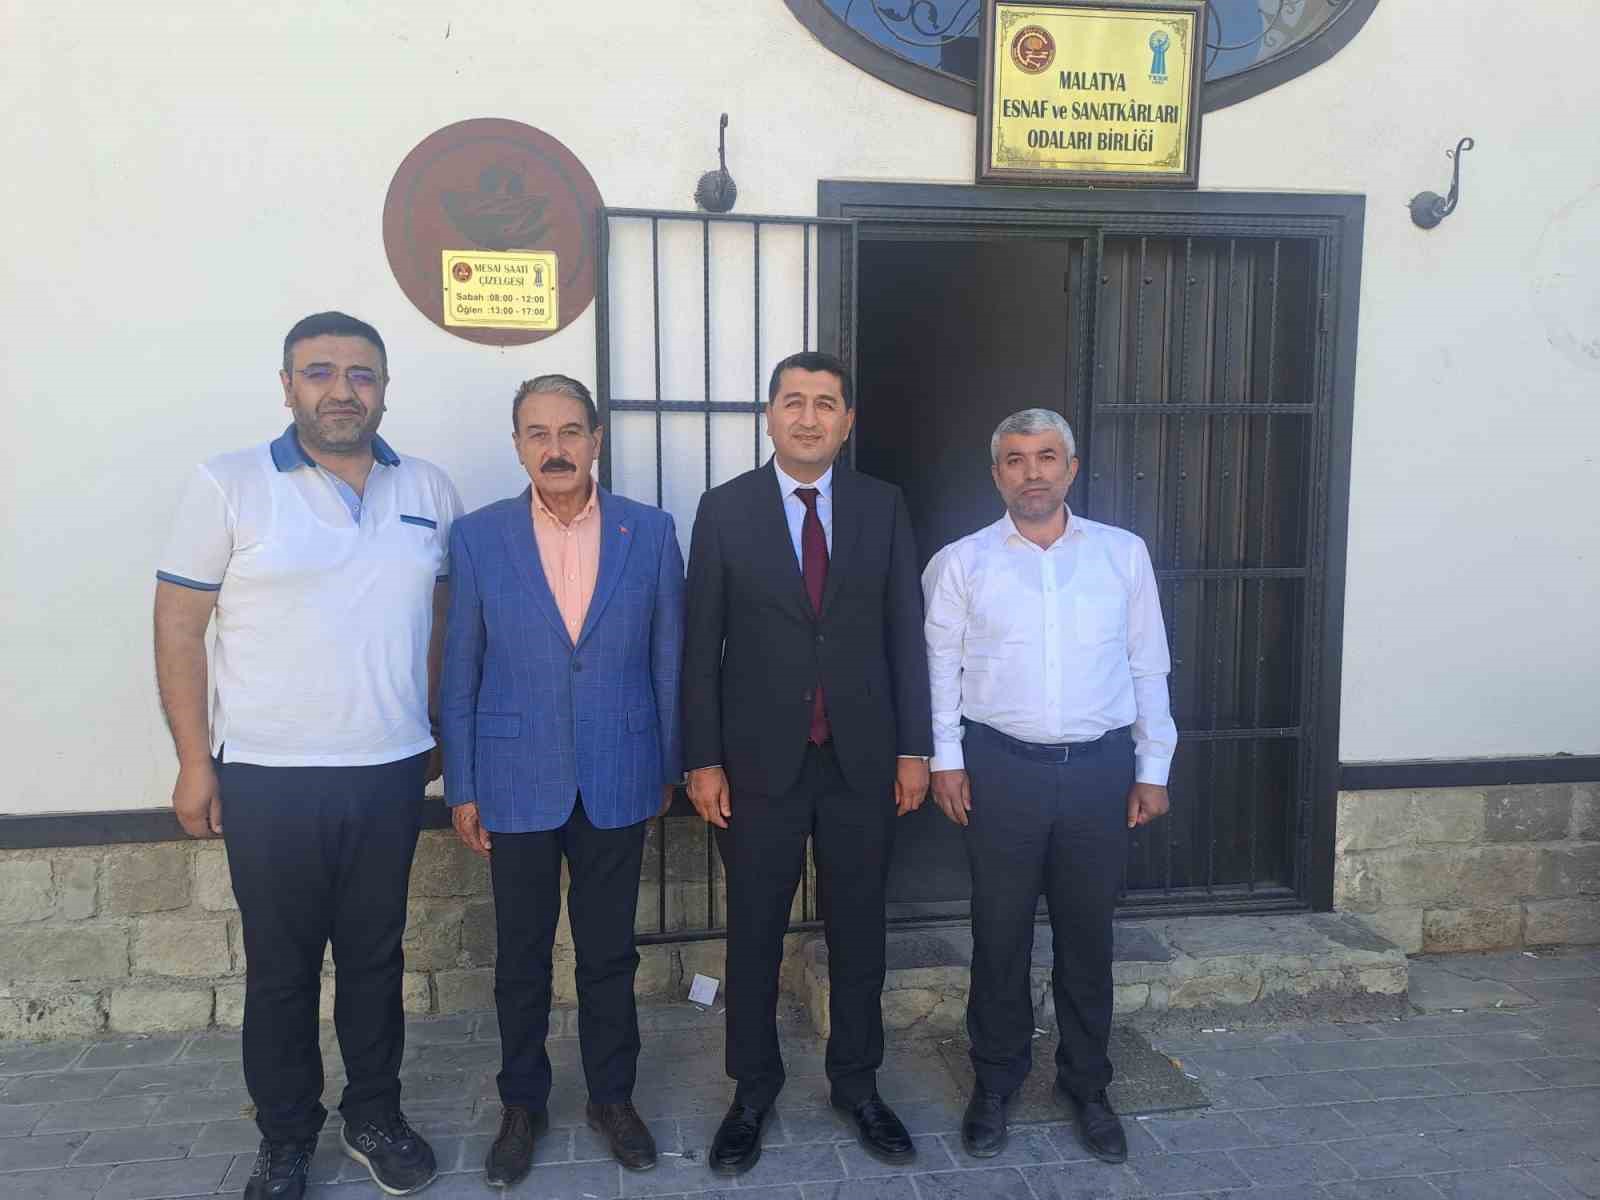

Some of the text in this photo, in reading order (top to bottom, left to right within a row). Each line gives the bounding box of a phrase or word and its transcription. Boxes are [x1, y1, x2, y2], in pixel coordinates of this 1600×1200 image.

[1059, 71, 1126, 92] MALATYA
[1003, 98, 1178, 123] ESNAF ve SANATKÂRLARI
[1028, 128, 1153, 152] ODALARI BİRLİĞİ
[456, 292, 484, 301] Sabah
[522, 295, 544, 303] 12:00
[456, 304, 483, 315] Öğlen
[522, 307, 544, 316] 17:00
